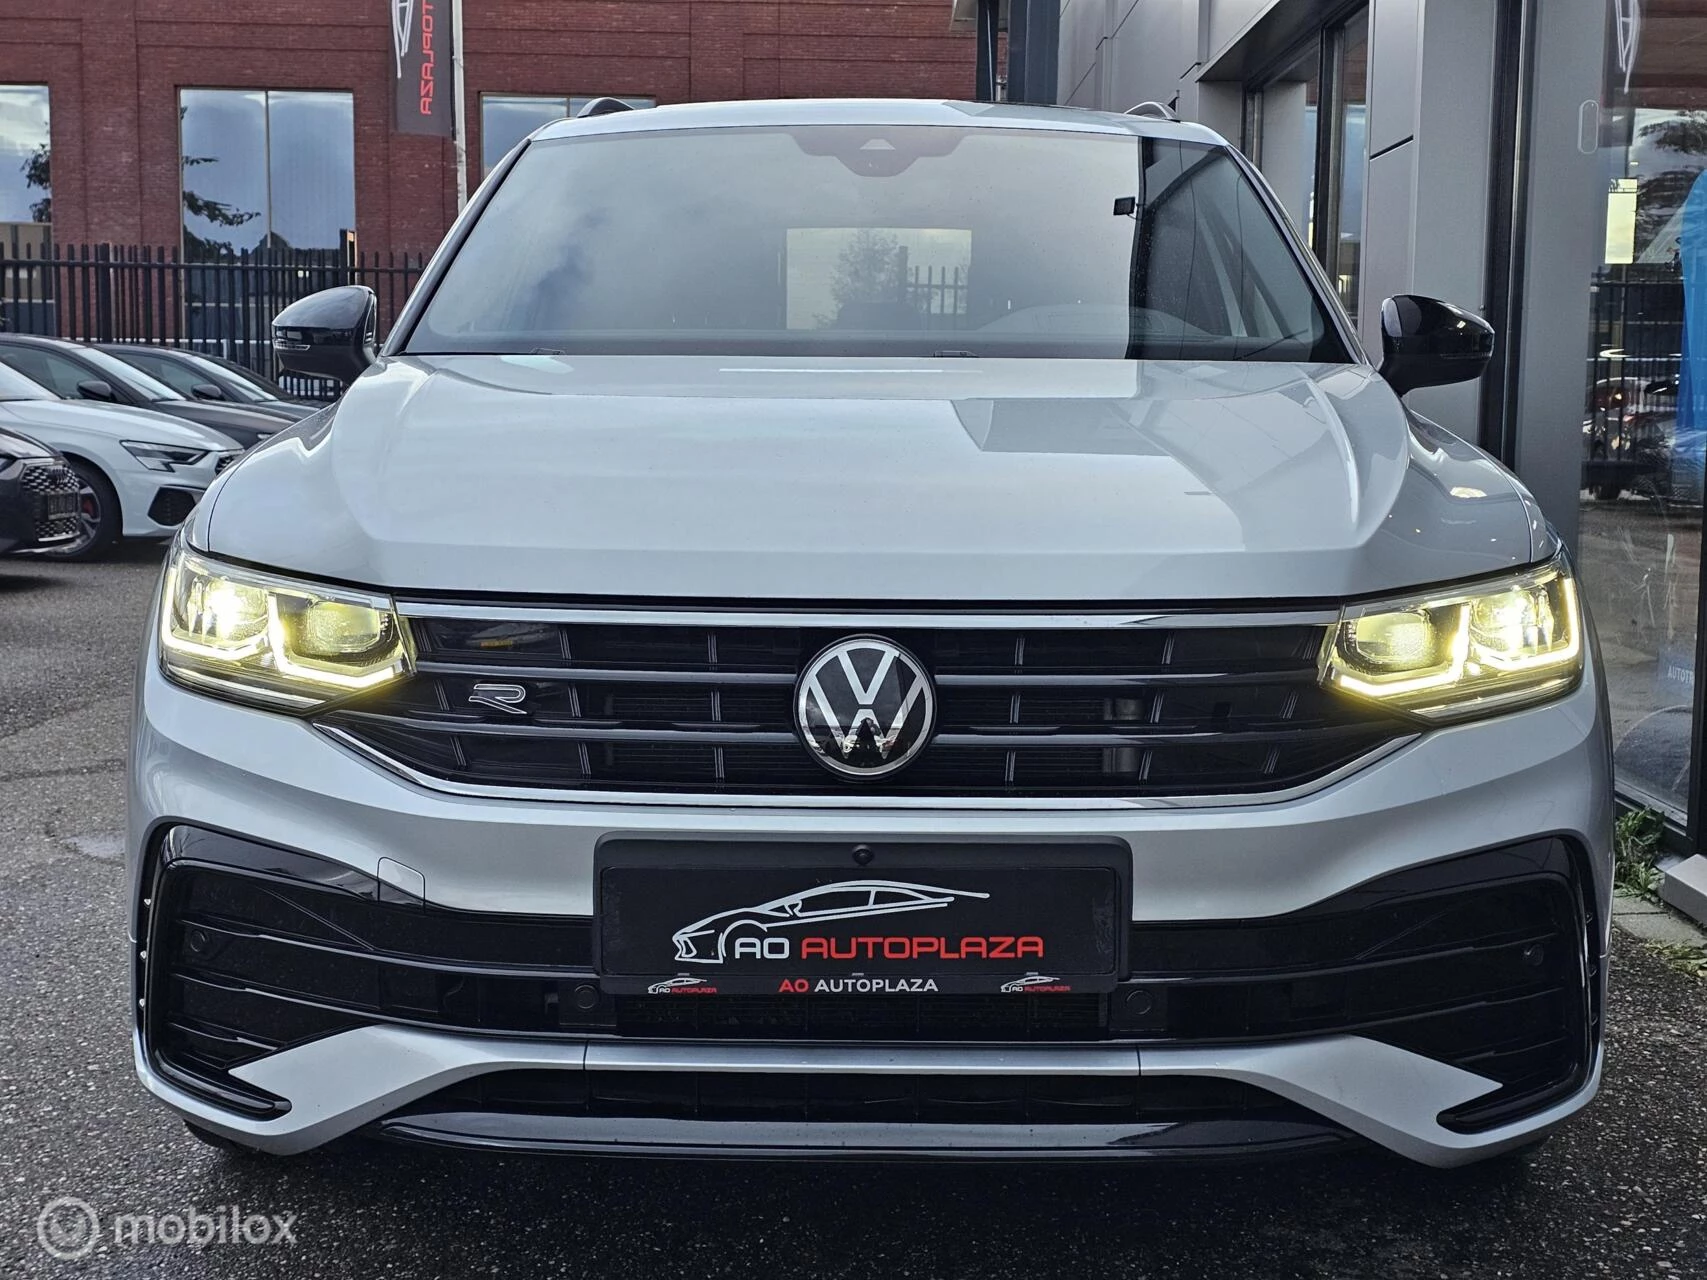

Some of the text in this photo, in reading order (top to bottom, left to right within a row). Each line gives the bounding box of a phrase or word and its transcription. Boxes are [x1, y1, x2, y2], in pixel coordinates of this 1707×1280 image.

[468, 683, 528, 715] R
[734, 936, 1044, 960] AO AUTOPLAZA
[778, 978, 939, 993] AO AUTOPLAZA
